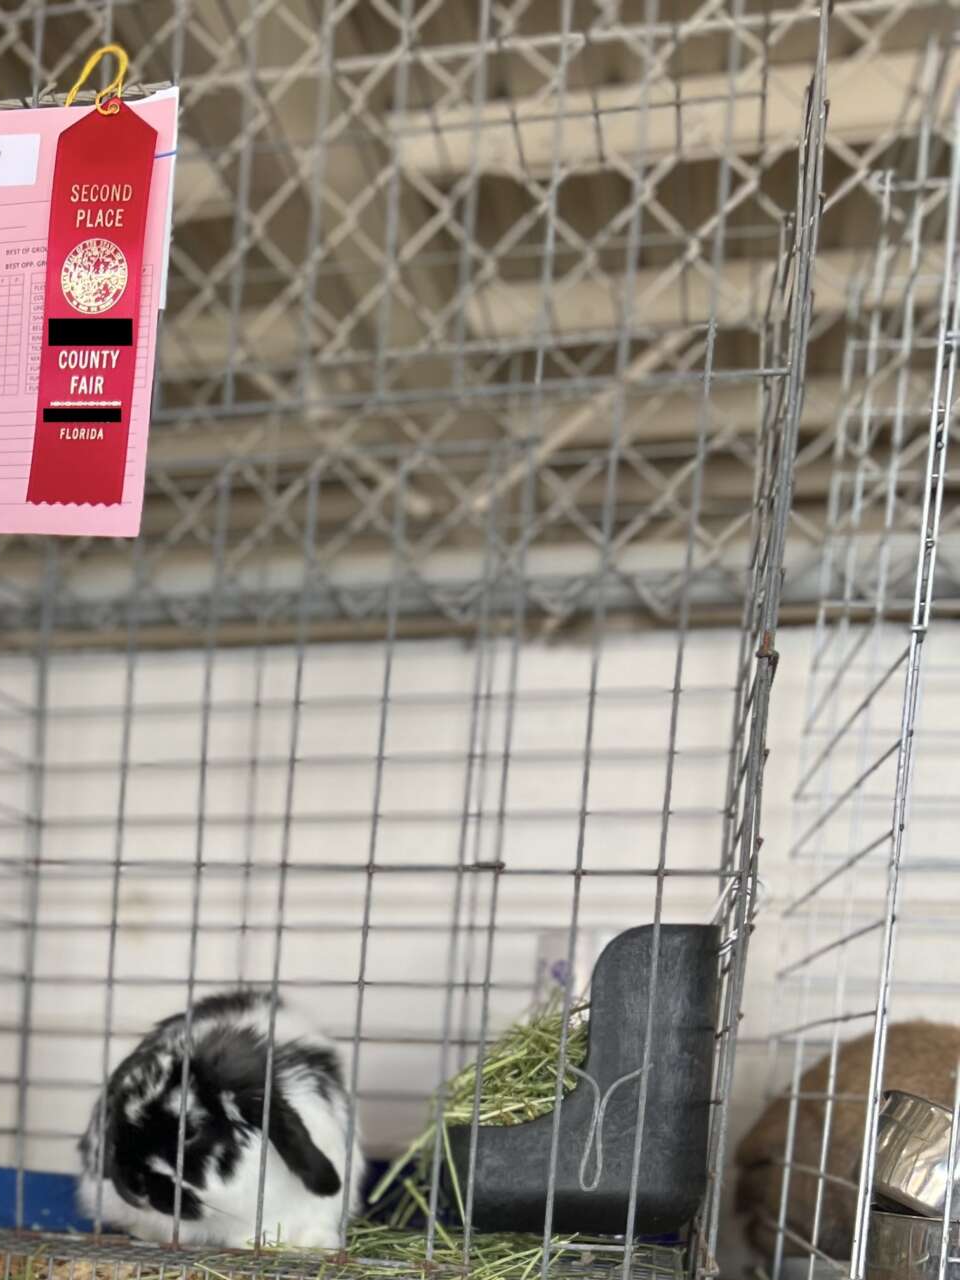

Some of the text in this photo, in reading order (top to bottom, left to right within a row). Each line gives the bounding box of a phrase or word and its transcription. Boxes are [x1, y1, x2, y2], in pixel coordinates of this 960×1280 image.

[70, 184, 133, 202] SECOND
[75, 208, 125, 228] PLACE
[5, 248, 20, 256] BEST
[5, 262, 20, 270] BEST
[58, 350, 120, 369] COUNTY
[70, 375, 105, 395] FAIR
[59, 427, 104, 440] FLORIDA
